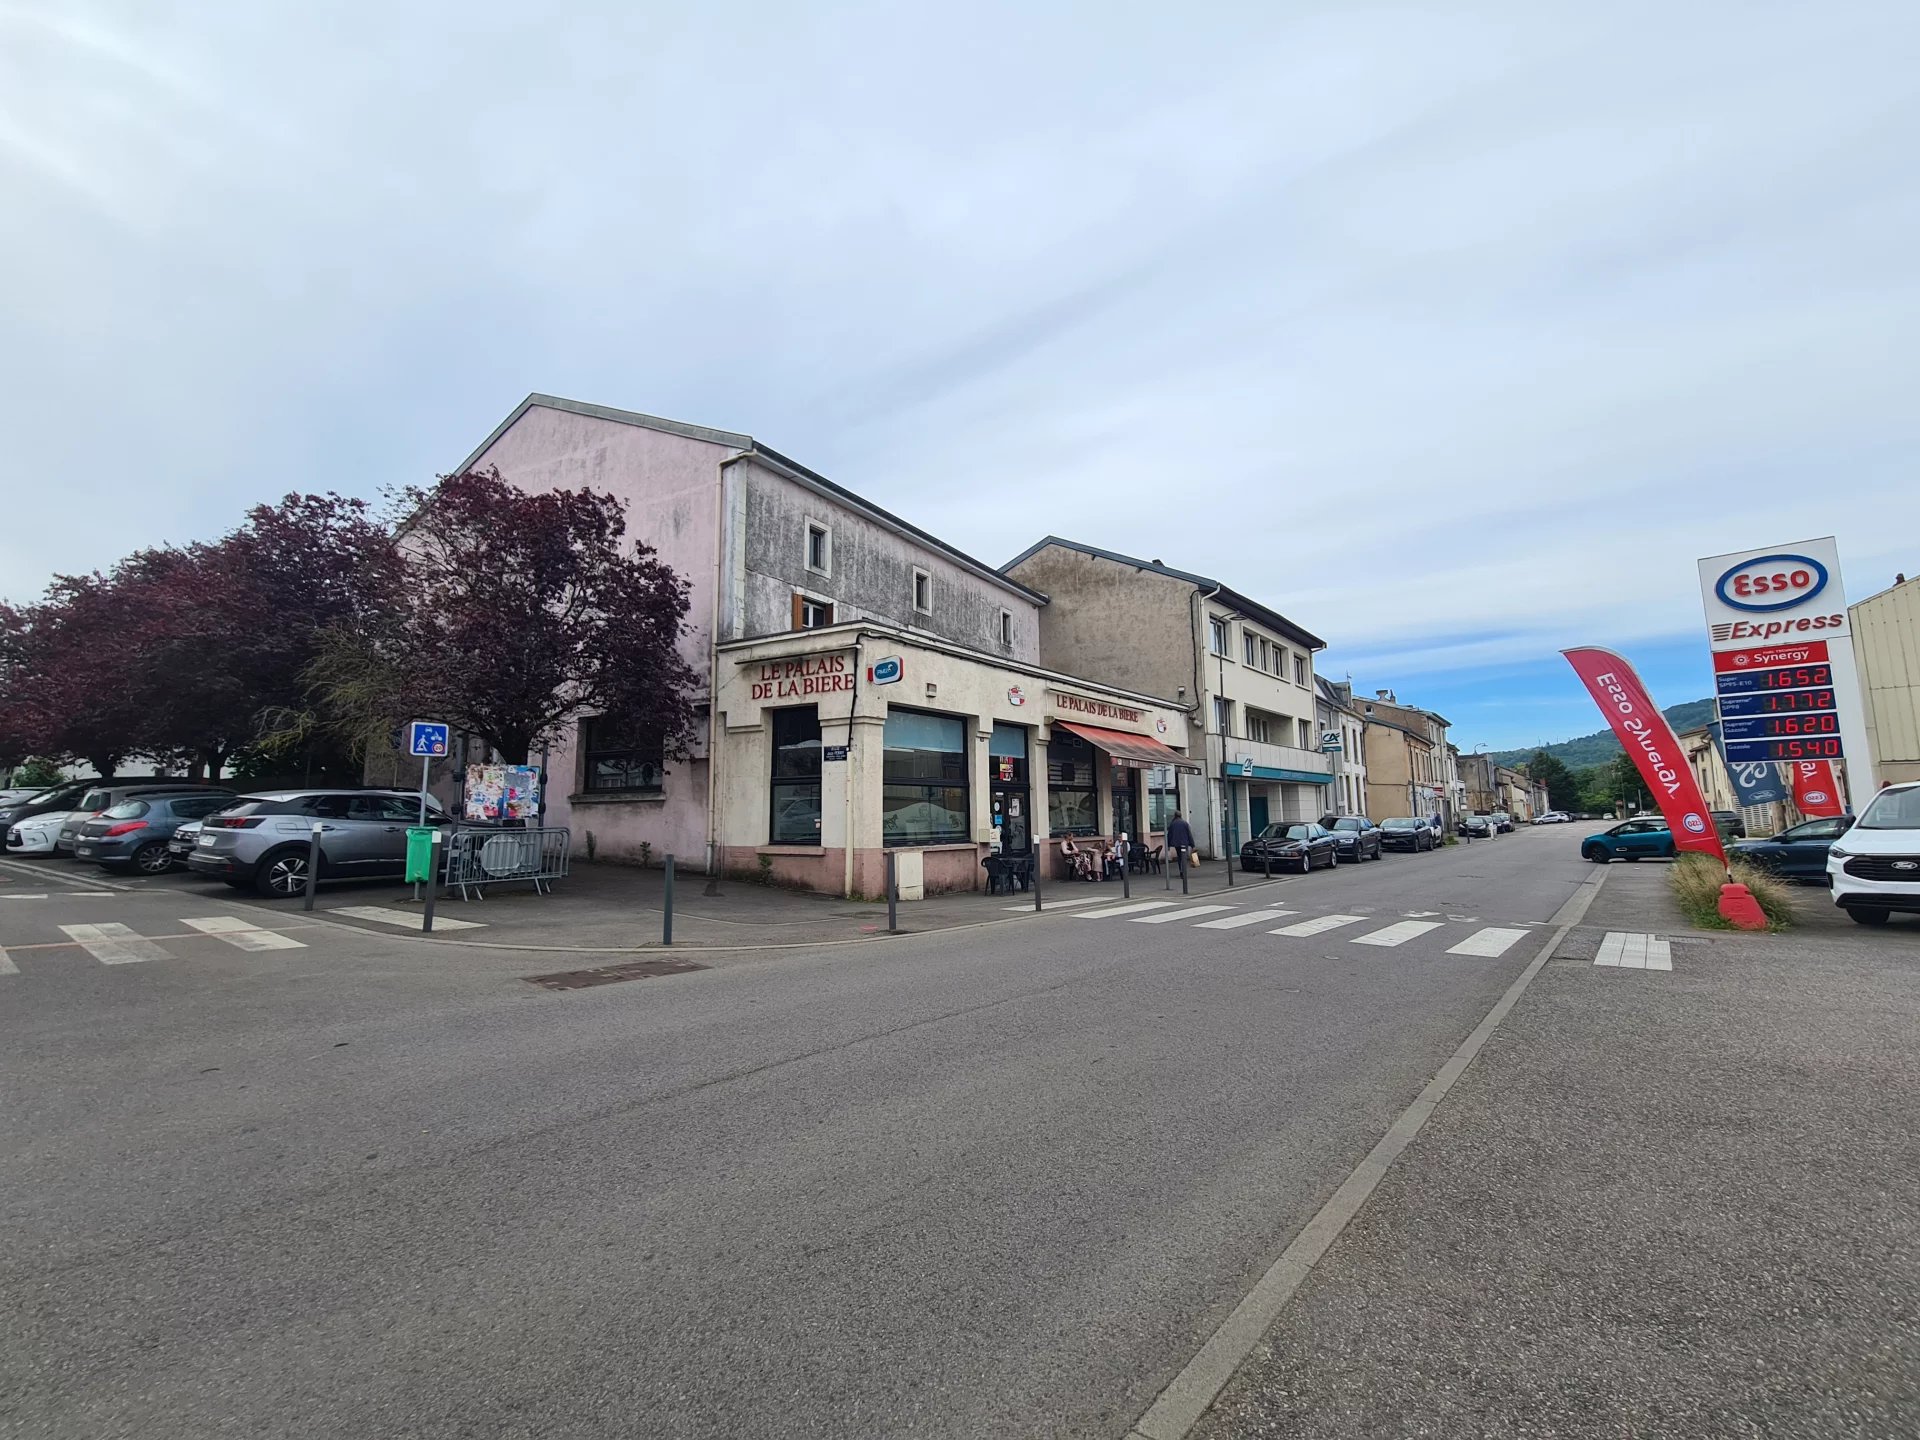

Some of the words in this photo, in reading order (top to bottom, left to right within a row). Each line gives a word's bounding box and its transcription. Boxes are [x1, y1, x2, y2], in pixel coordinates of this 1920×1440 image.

[1733, 570, 1810, 597] Esso
[1730, 613, 1844, 640] Express
[761, 663, 781, 681] LE
[785, 655, 845, 679] PALAIS
[1753, 650, 1810, 664] Synergy
[752, 682, 773, 700] DE
[778, 680, 800, 697] LA
[803, 673, 855, 695] BIERE
[1768, 667, 1827, 687] 1.652
[1056, 694, 1068, 709] LE
[1068, 697, 1096, 714] PALAIS
[1097, 703, 1108, 717] DE
[1108, 706, 1119, 719] LA
[1119, 708, 1139, 723] BIERE
[1771, 691, 1831, 710] 1.772
[1775, 715, 1835, 734] 1.620
[1778, 739, 1839, 757] 1.540
